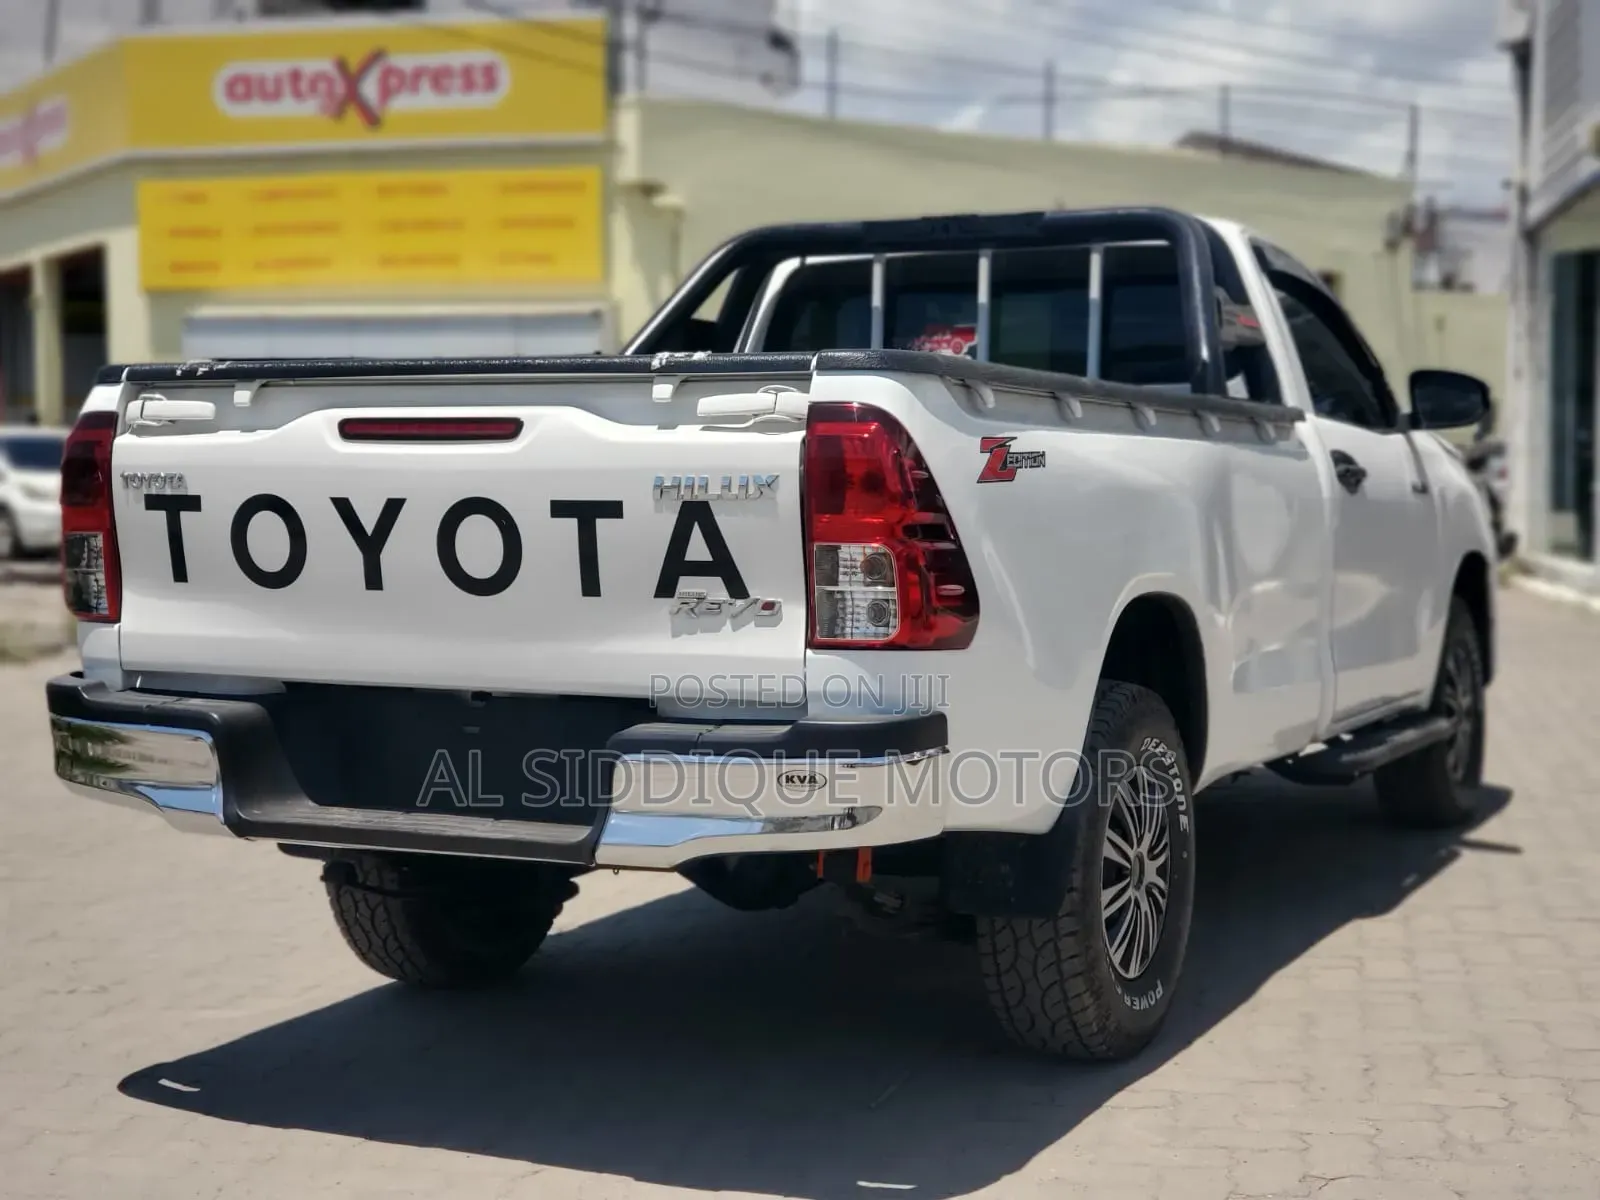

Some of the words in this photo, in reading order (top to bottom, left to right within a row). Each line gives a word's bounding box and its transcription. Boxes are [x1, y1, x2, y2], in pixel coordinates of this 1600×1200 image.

[223, 47, 501, 130] autoXpress
[120, 471, 187, 489] TOYOTA
[653, 473, 780, 501] HILUX
[144, 493, 751, 599] TOYOTA
[785, 774, 819, 785] KVA
